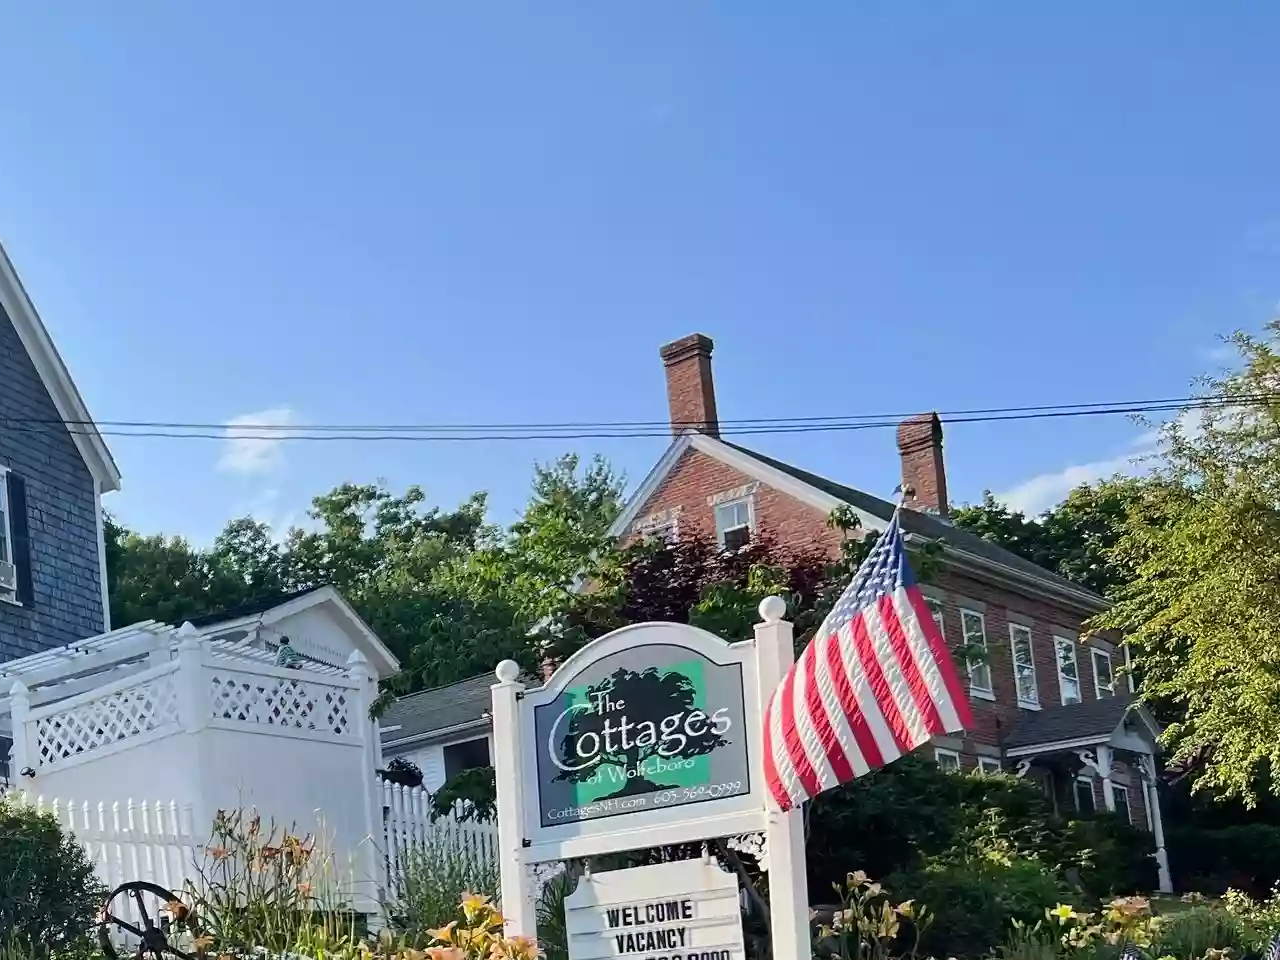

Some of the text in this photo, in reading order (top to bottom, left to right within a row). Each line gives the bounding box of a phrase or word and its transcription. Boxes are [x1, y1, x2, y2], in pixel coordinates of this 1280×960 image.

[591, 691, 625, 715] The
[548, 703, 732, 772] Cottages
[587, 757, 695, 785] of Wolfeboro
[547, 796, 646, 820] CottagesNH.com
[606, 899, 693, 928] WELCOME
[615, 927, 686, 954] VACANCY
